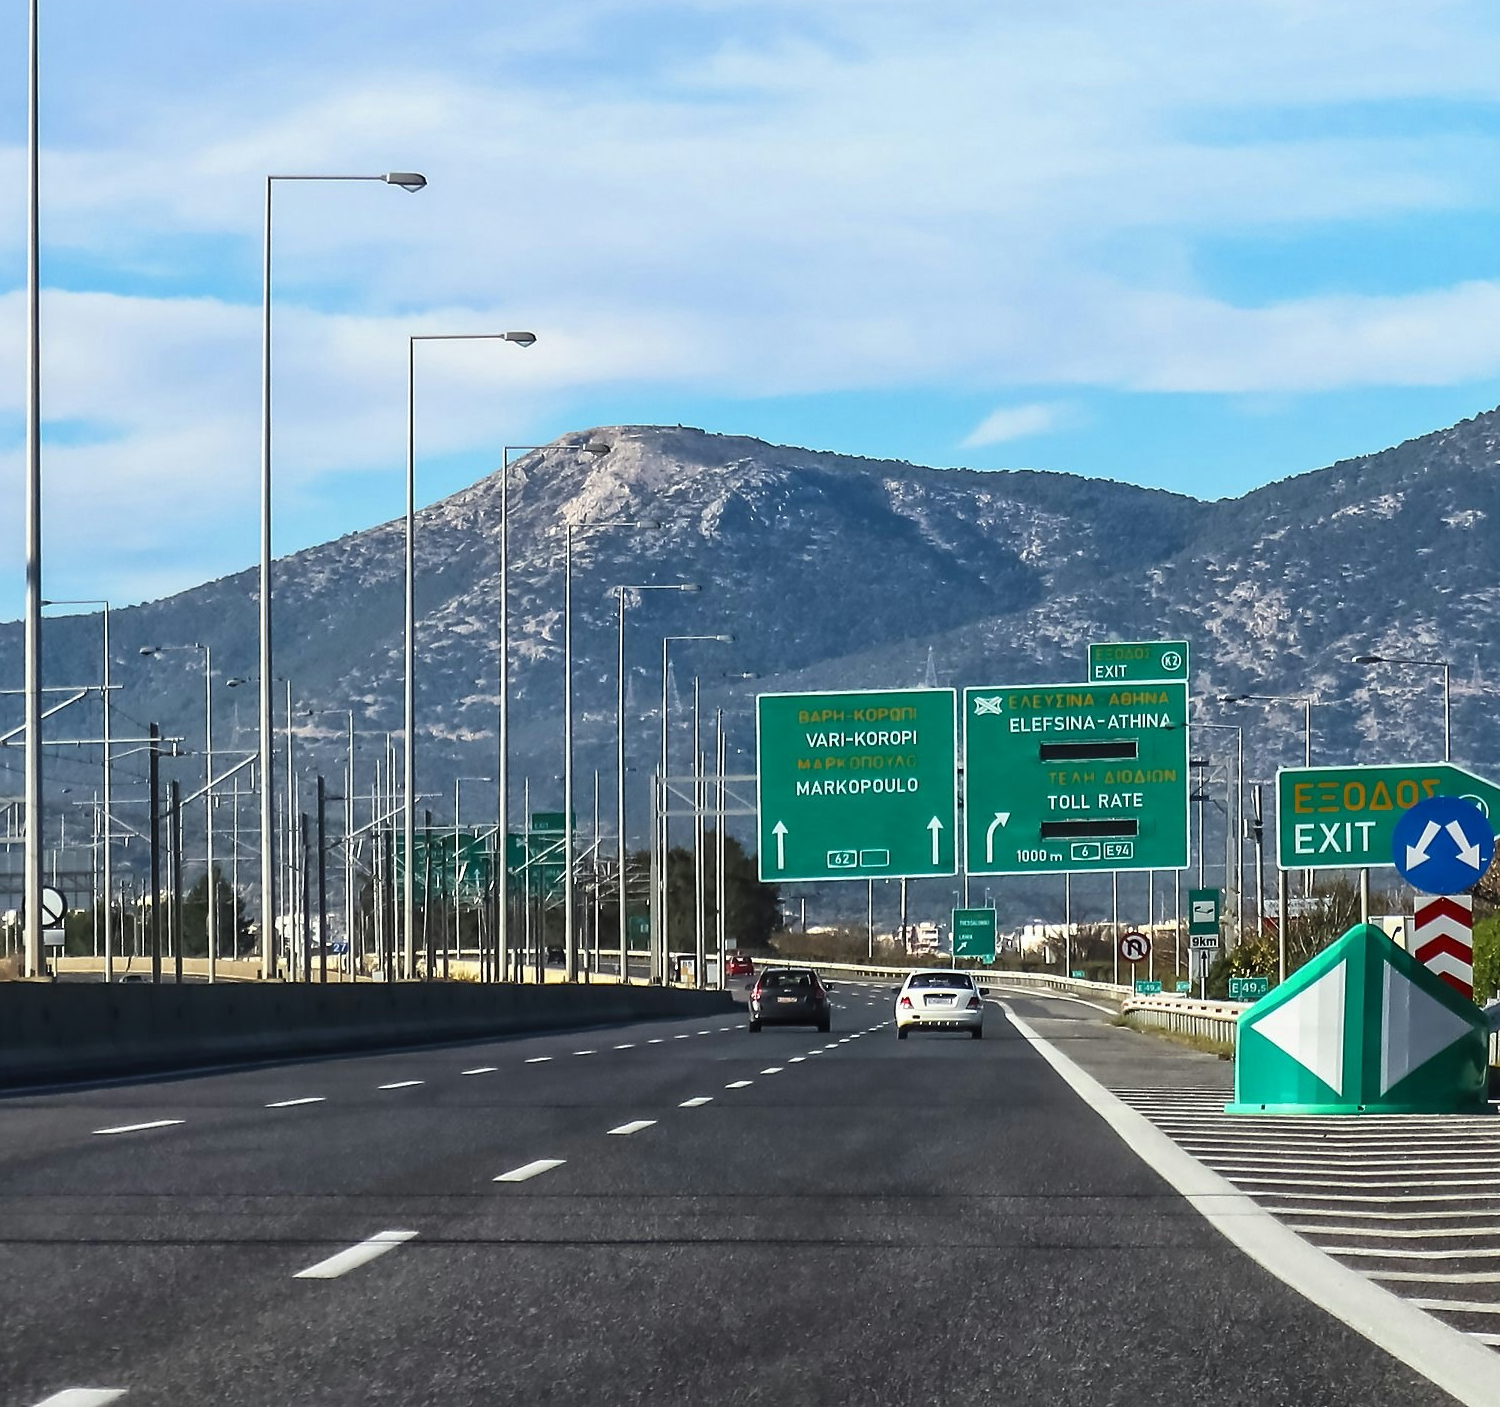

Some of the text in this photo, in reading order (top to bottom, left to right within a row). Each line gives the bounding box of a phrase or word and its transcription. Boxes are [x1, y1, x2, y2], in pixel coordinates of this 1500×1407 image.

[1164, 655, 1178, 667] K2
[1095, 664, 1127, 679] EXIT
[1009, 712, 1171, 733] ELEFSINA-ATHINA
[806, 730, 917, 748] VARI-KOROPI
[796, 777, 919, 796] MARKOPOULO
[1048, 771, 1095, 786] ΤΕΛΗ
[1047, 792, 1143, 810] TOLL RATE
[1294, 779, 1441, 814] ΕΞΟΔΟΣ
[1294, 821, 1377, 854] EXIT
[835, 853, 849, 864] 62
[1017, 849, 1047, 863] 1000
[1050, 853, 1062, 861] m
[1081, 846, 1089, 857] 6
[333, 943, 347, 952] 27
[1192, 936, 1217, 947] 9km
[1232, 982, 1239, 993] E
